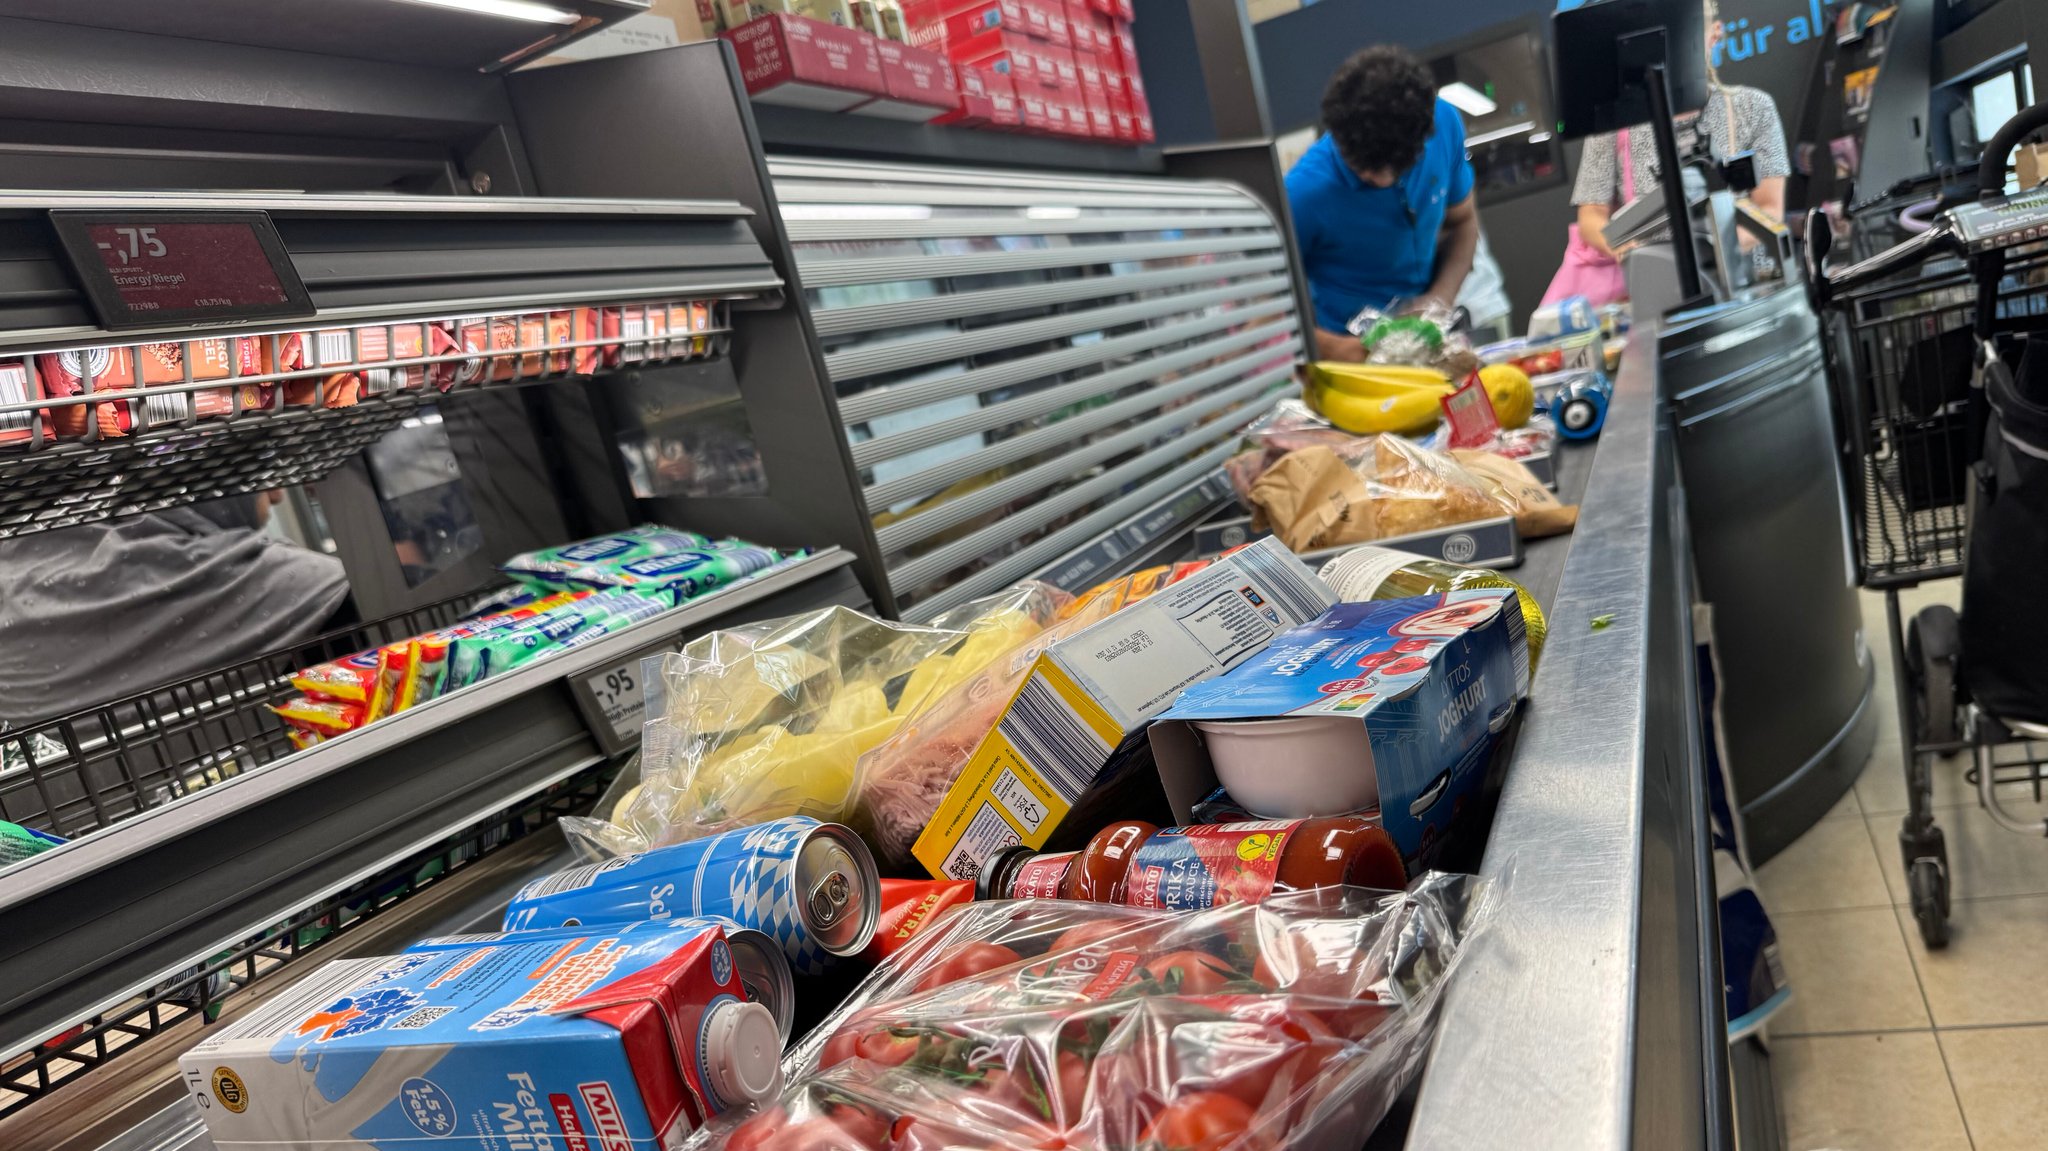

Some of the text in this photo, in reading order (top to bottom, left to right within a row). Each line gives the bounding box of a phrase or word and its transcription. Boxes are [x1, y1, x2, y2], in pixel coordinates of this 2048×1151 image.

[1787, 0, 1835, 44] al
[114, 272, 185, 288] Energy Riegel
[242, 341, 252, 368] SPORTS
[1271, 638, 1345, 677] JOGHURT
[1440, 660, 1471, 698] LYTTOS
[1438, 674, 1487, 743] JOGHURT
[1267, 833, 1286, 860] VEGAN
[894, 893, 940, 938] EXTRA
[510, 956, 584, 1007] WECHSEL
[221, 1076, 240, 1101] DLG
[404, 1088, 431, 1127] Fett
